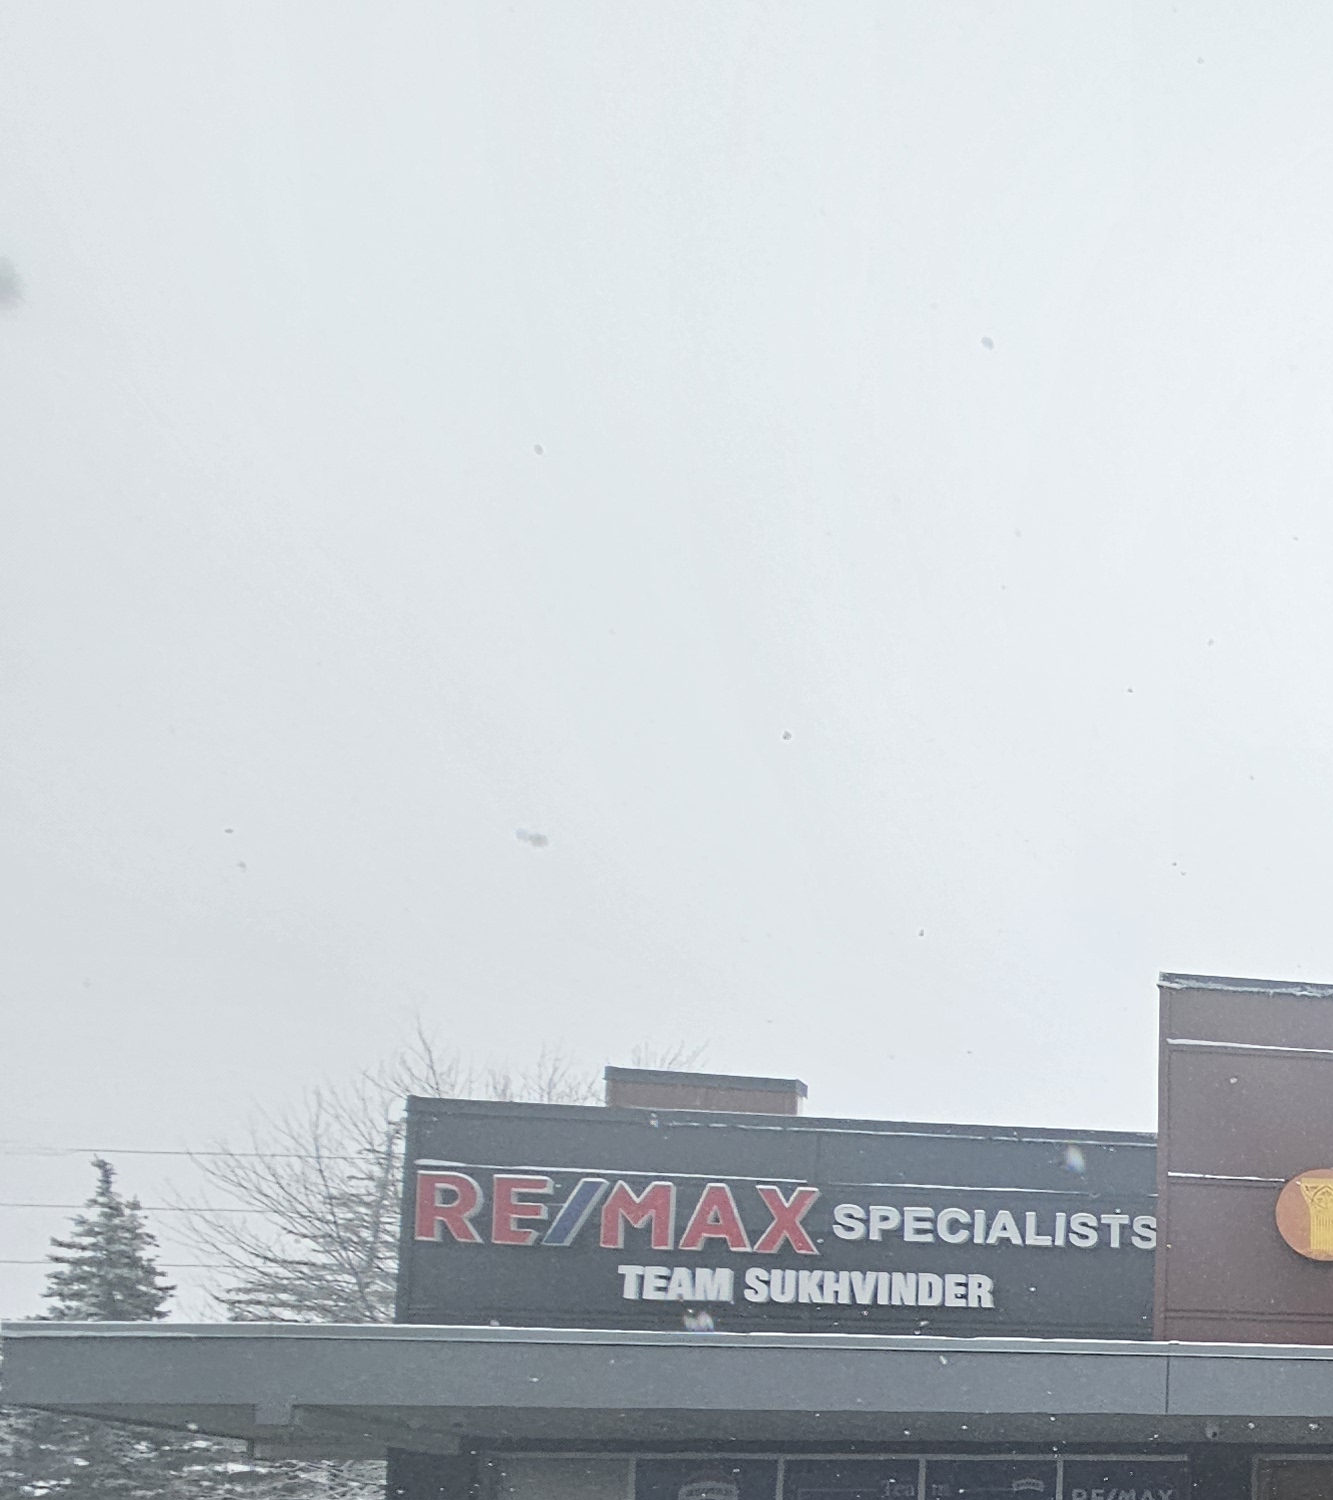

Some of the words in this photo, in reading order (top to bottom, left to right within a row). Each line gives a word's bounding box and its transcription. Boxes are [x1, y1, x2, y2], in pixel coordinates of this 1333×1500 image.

[415, 1170, 820, 1254] RE/MAX
[832, 1204, 1157, 1249] SPECIALISTS
[617, 1264, 734, 1302] TEAM
[744, 1269, 995, 1308] SUKHVINDER
